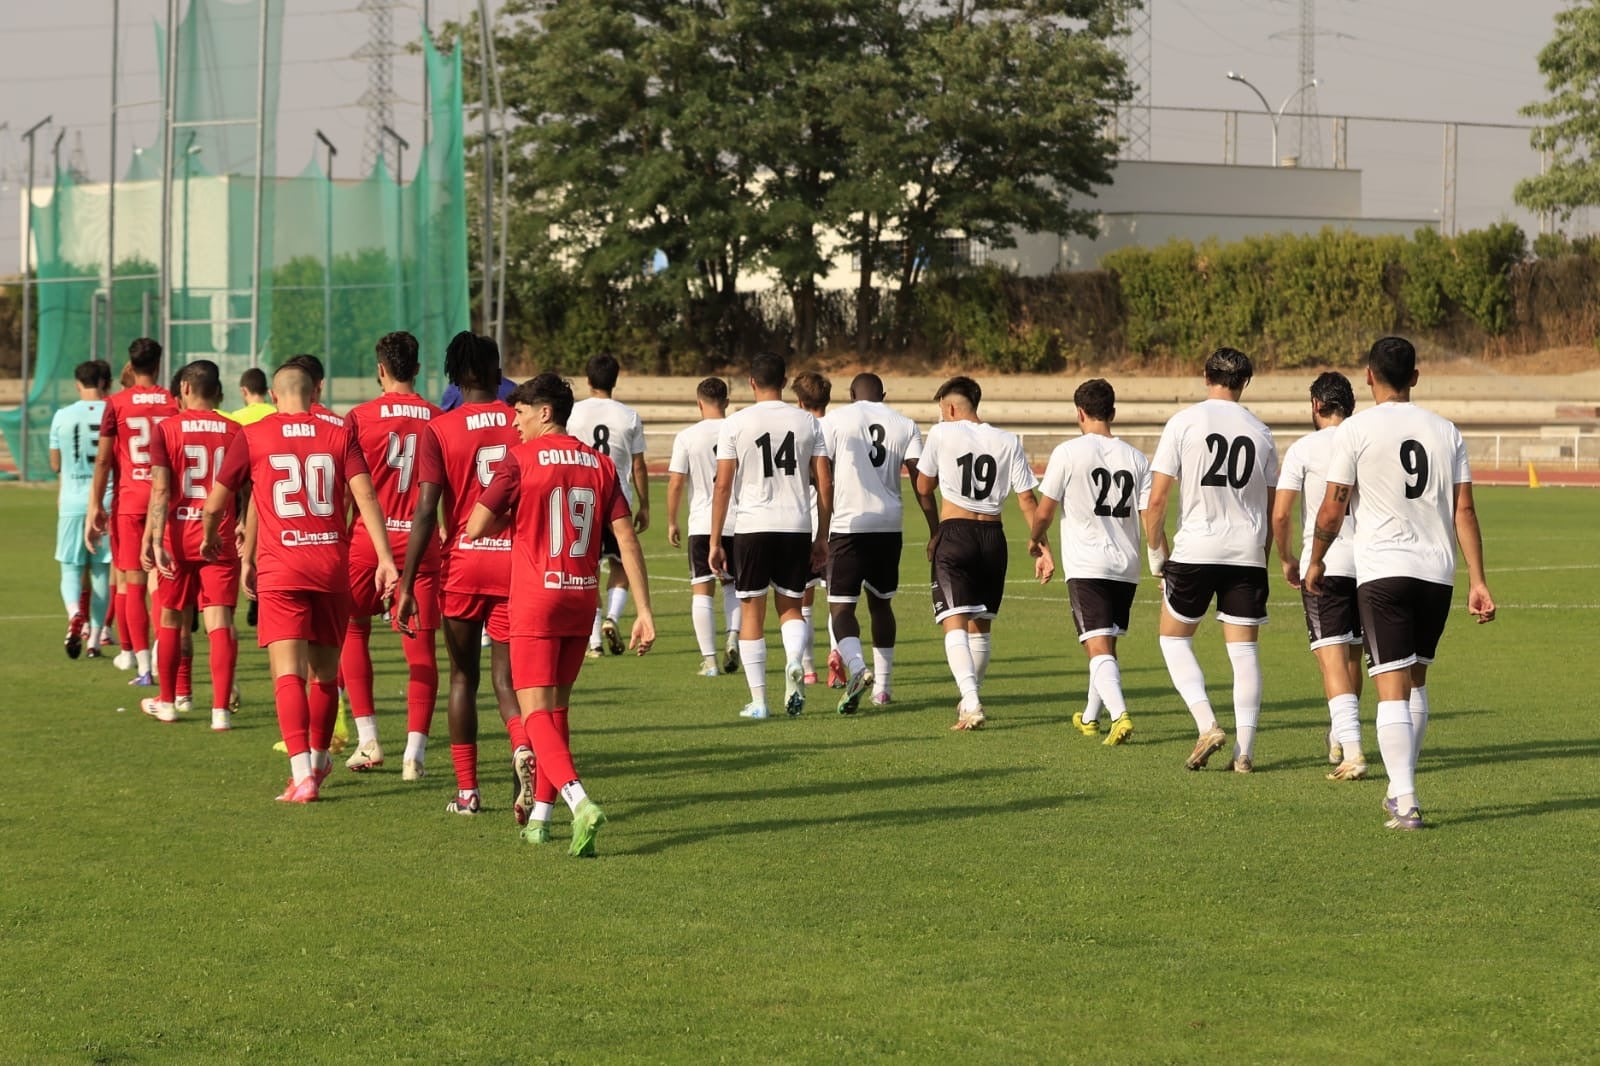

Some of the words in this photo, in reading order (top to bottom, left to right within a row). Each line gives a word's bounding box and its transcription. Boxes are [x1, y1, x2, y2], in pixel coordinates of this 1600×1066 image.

[181, 420, 227, 434] RAZVAN
[282, 423, 316, 438] GABI
[380, 404, 431, 421] A.DAVID
[466, 412, 507, 431] MAYO
[125, 416, 169, 465] 2
[386, 431, 417, 493] 4
[538, 449, 599, 469] COLLADO
[593, 424, 611, 457] 8
[755, 430, 797, 478] 14
[869, 423, 886, 468] 3
[1200, 433, 1256, 490] 20
[269, 453, 336, 519] 20
[957, 452, 997, 501] 19
[1091, 467, 1135, 519] 22
[1400, 439, 1429, 500] 9
[473, 536, 512, 547] Limca
[549, 486, 597, 558] 19
